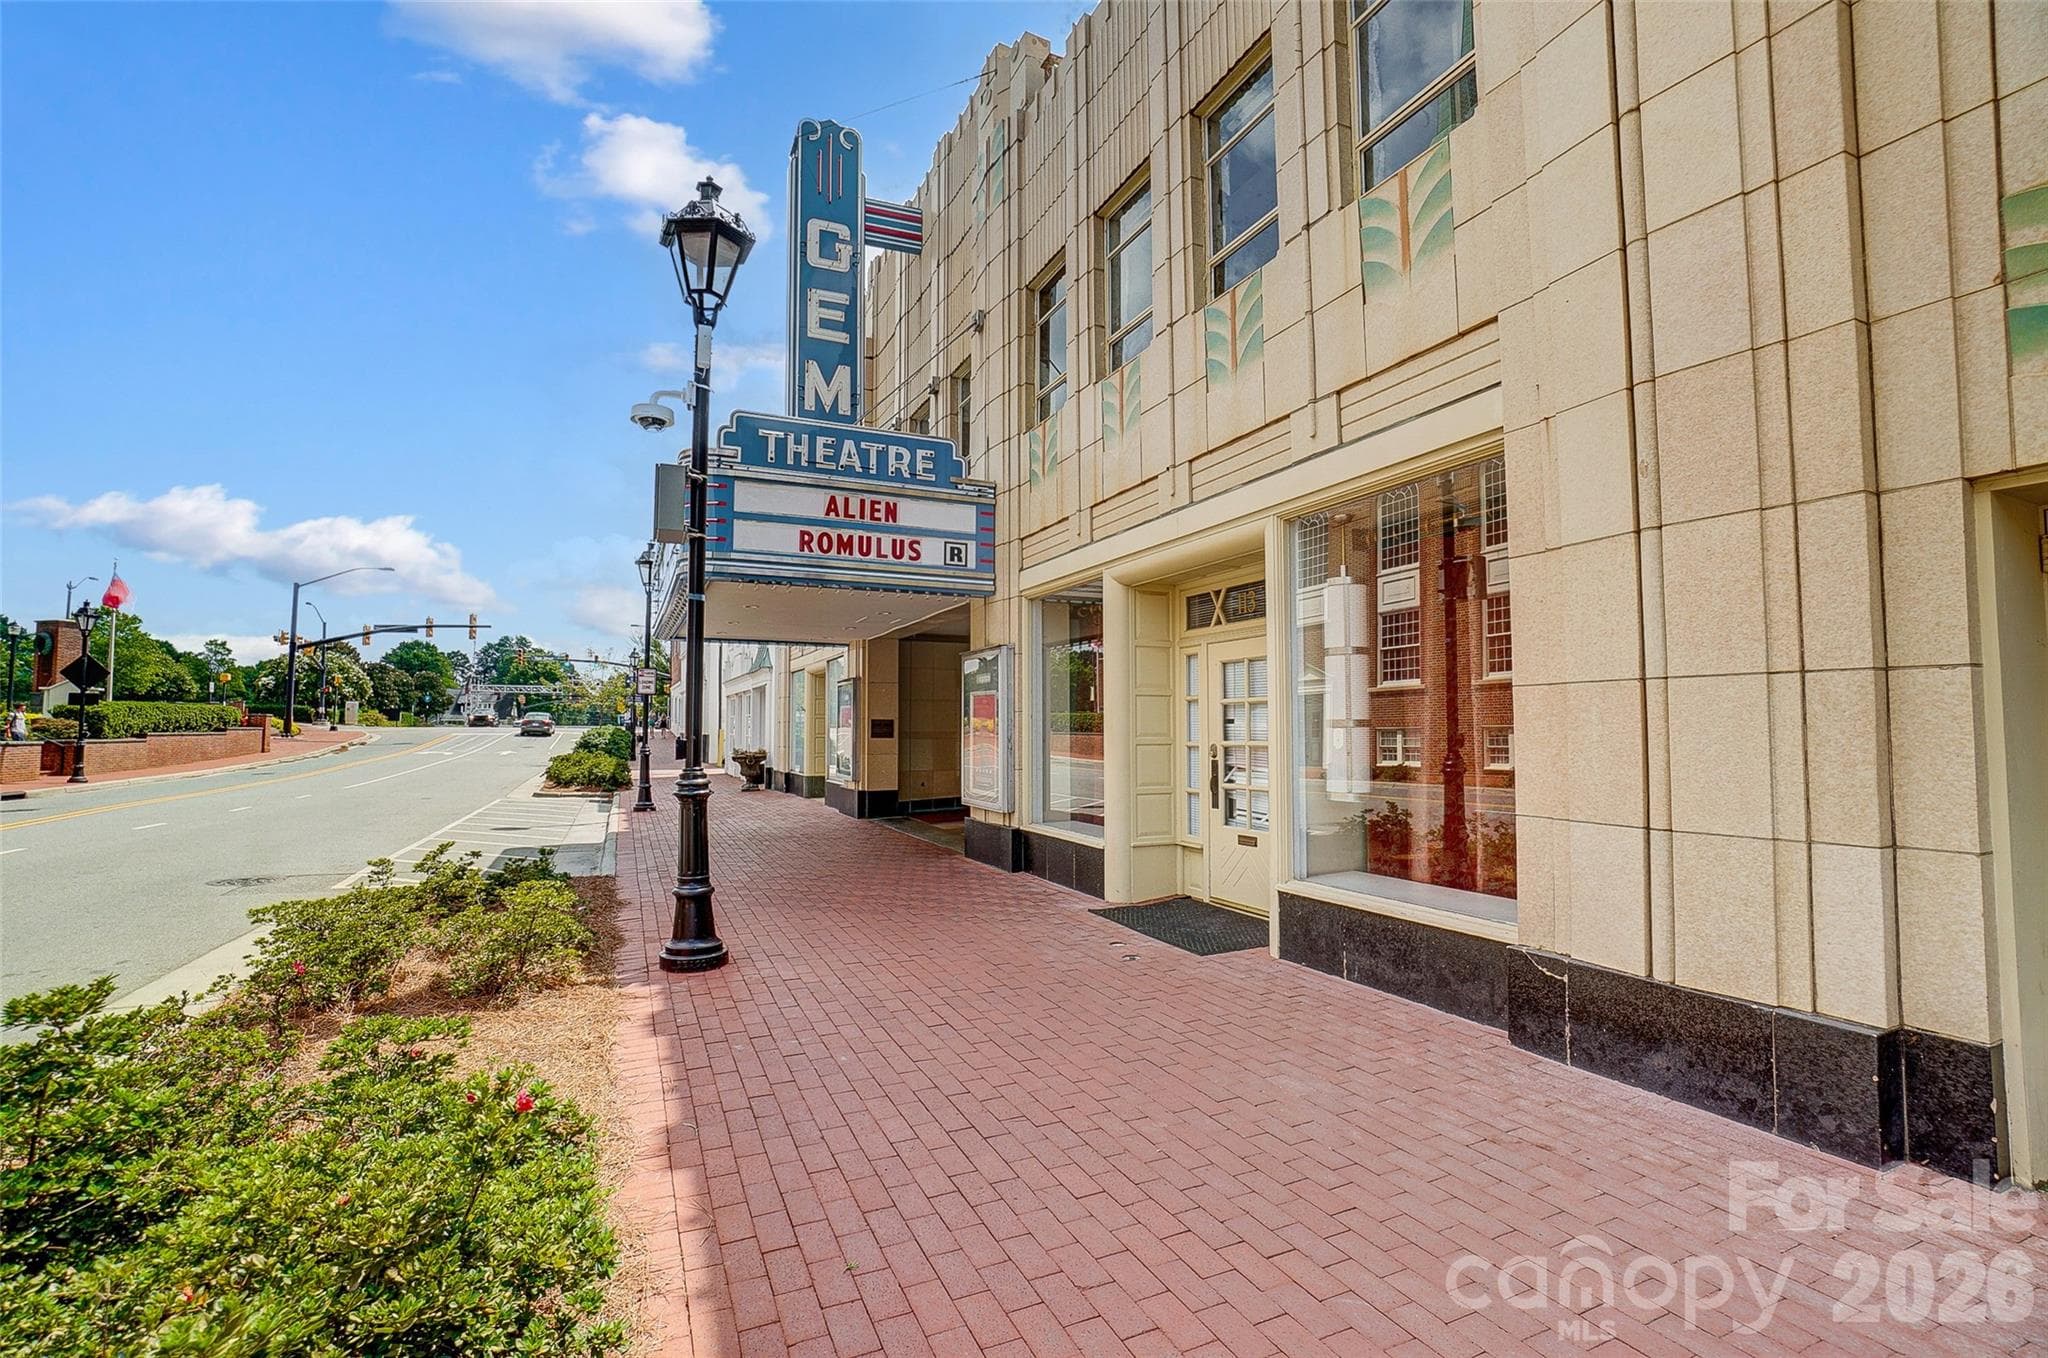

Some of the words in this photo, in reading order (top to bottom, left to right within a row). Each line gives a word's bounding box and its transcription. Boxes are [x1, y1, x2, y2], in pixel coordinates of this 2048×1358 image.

[806, 218, 853, 416] GEM
[758, 428, 936, 481] THEATRE
[824, 495, 898, 524] ALIEN
[799, 529, 921, 561] ROMULUS
[1238, 590, 1256, 614] 113
